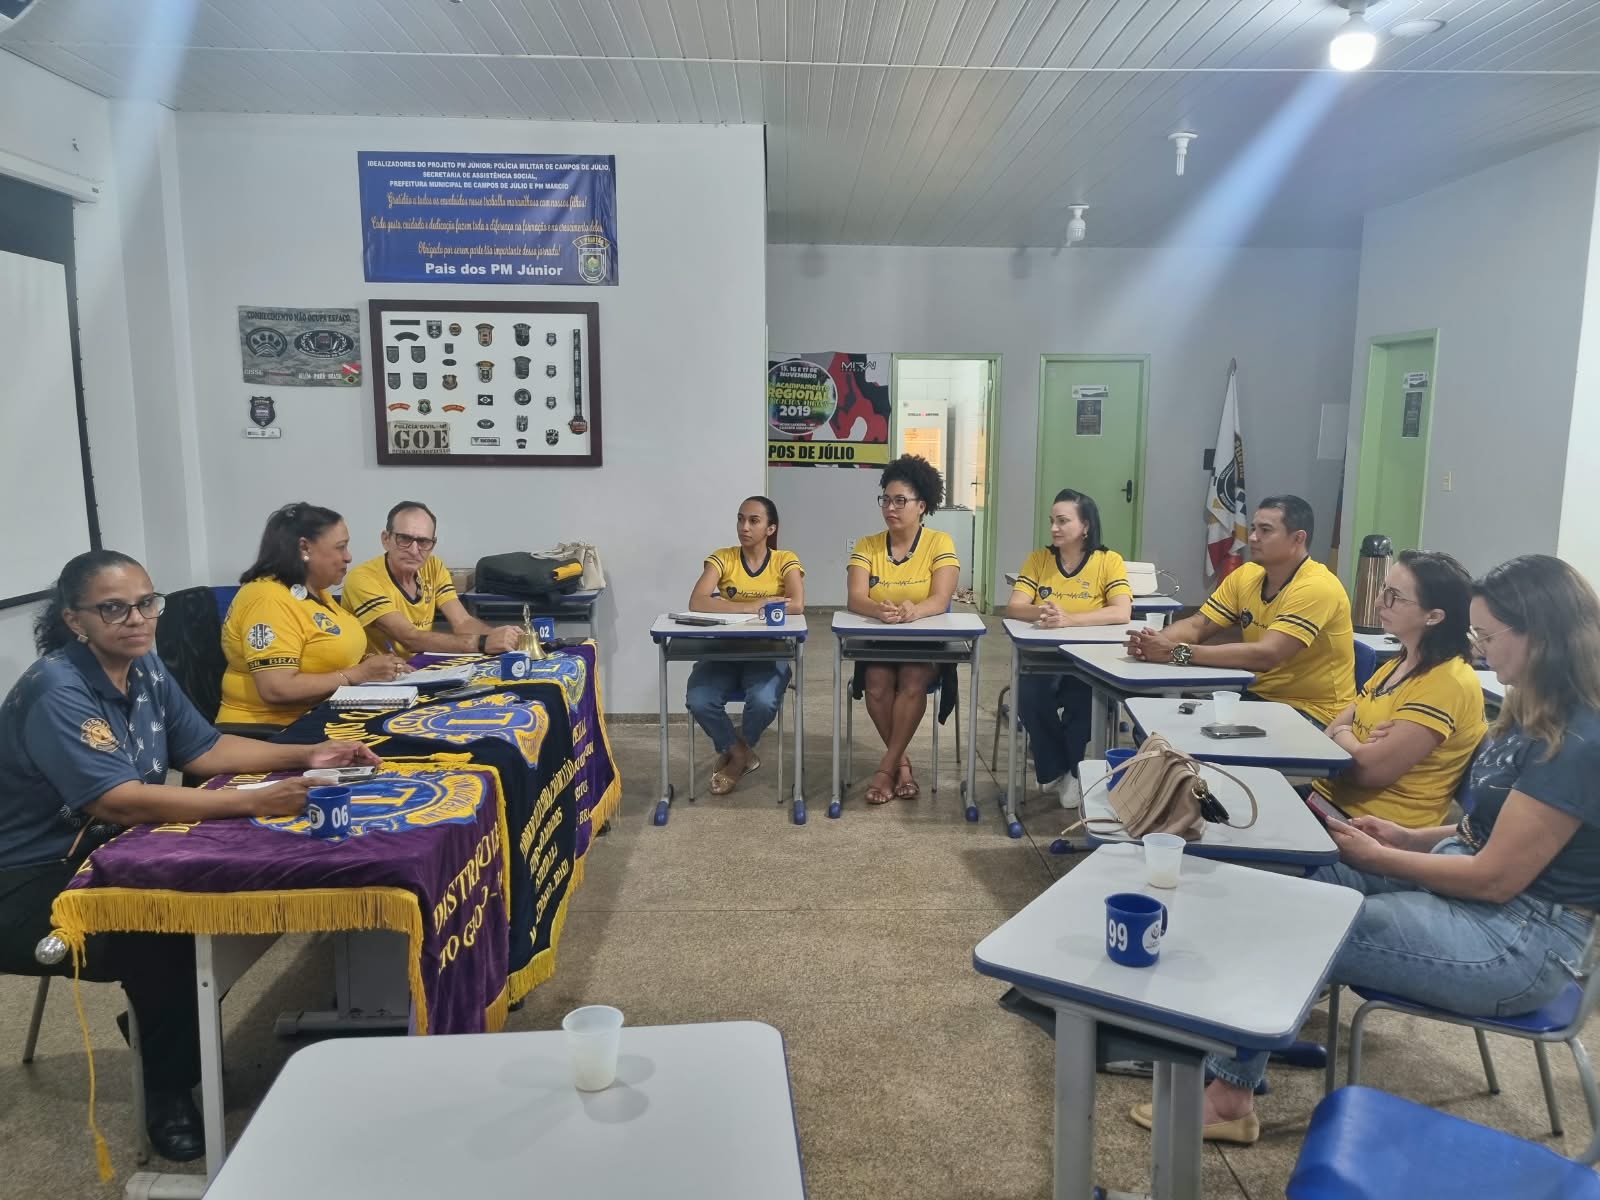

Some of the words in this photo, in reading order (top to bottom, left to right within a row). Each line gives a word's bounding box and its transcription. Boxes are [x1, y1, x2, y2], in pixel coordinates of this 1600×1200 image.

[367, 160, 416, 168] IDEALIZADORES
[427, 161, 456, 169] PROJETO
[493, 161, 518, 170] POLÍCIA
[389, 180, 428, 188] PREFEITURA
[425, 262, 457, 275] Pais
[460, 263, 487, 275] dos
[490, 263, 513, 275] PM
[516, 263, 564, 276] Júnior
[779, 405, 811, 417] 2019
[394, 430, 449, 449] GOE
[768, 444, 796, 459] POS
[798, 445, 816, 460] DE
[817, 443, 855, 460] JÚLIO
[539, 625, 550, 639] 02
[331, 804, 349, 829] 06
[1108, 919, 1128, 952] 99
